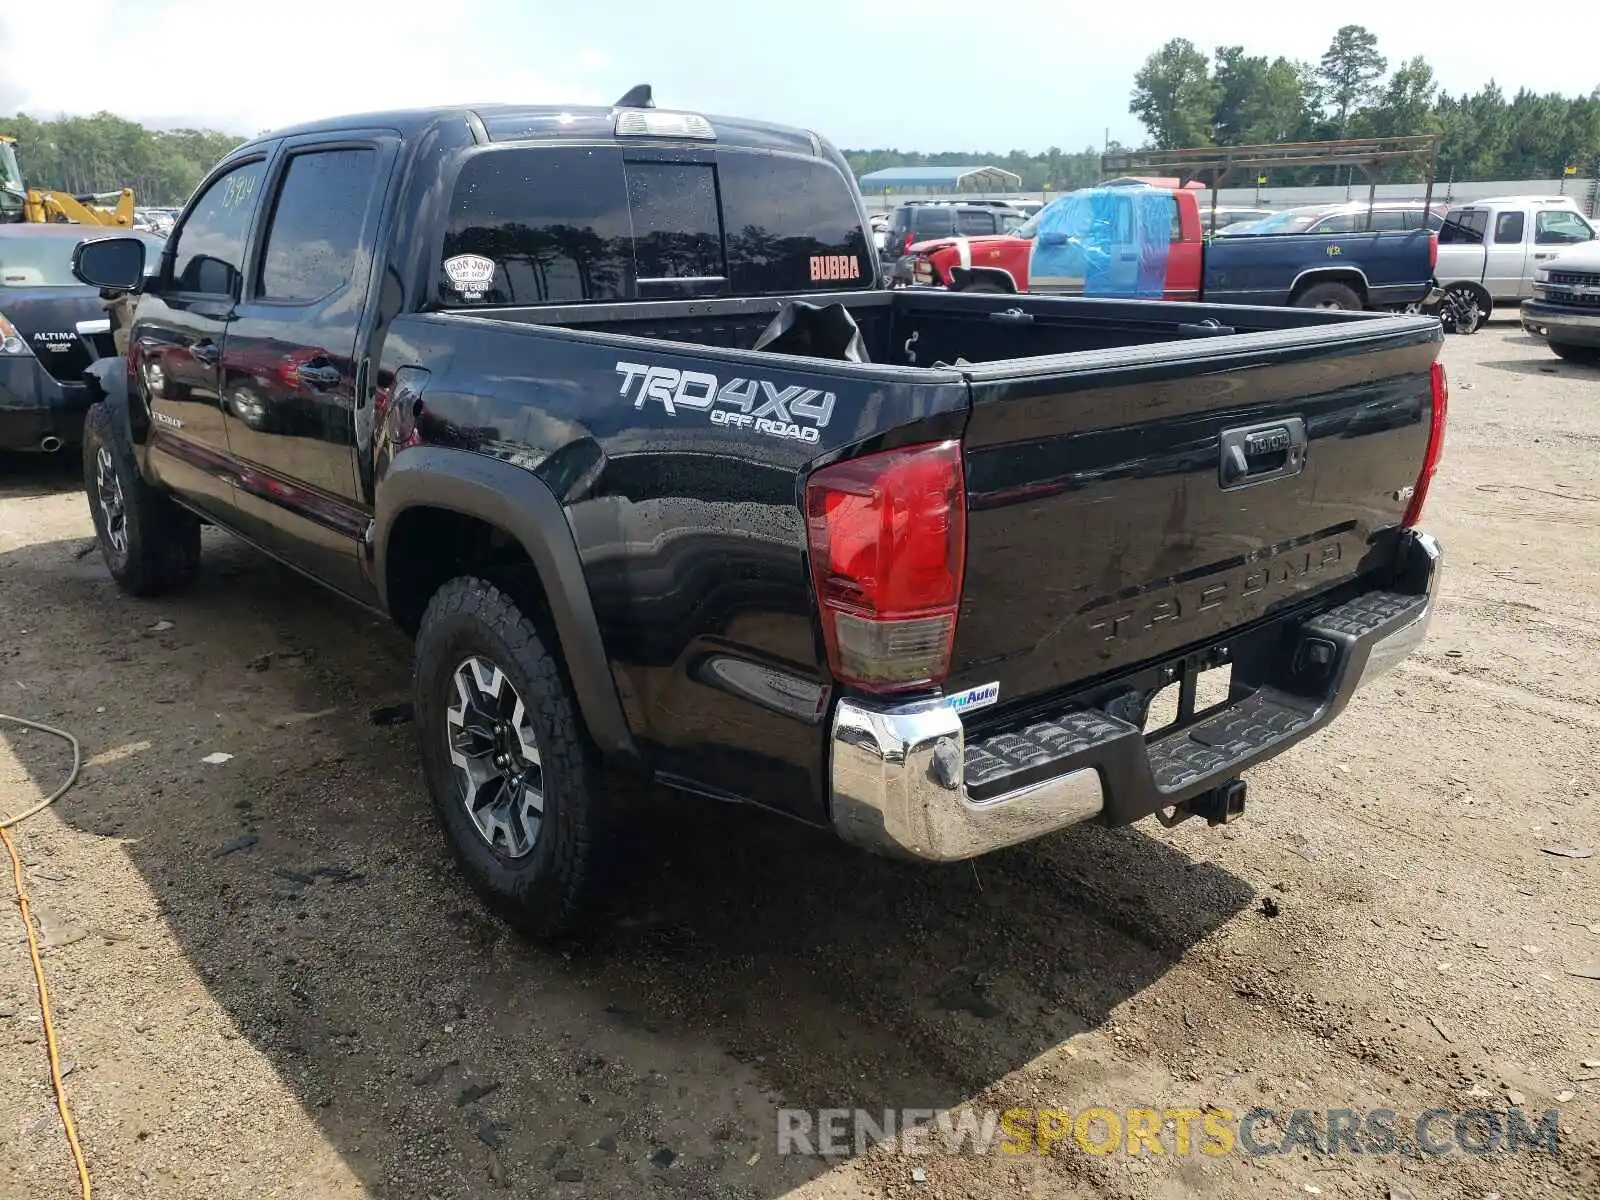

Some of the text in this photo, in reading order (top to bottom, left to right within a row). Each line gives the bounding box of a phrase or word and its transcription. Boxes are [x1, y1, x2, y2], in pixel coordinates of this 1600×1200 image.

[449, 259, 491, 273] RON JON
[810, 255, 860, 281] BUBBA
[33, 332, 78, 341] ALTIMA
[615, 361, 719, 416] TRD
[710, 409, 820, 444] OFF ROAD
[1252, 432, 1289, 454] TOYOTA
[1088, 542, 1343, 641] TACOMA
